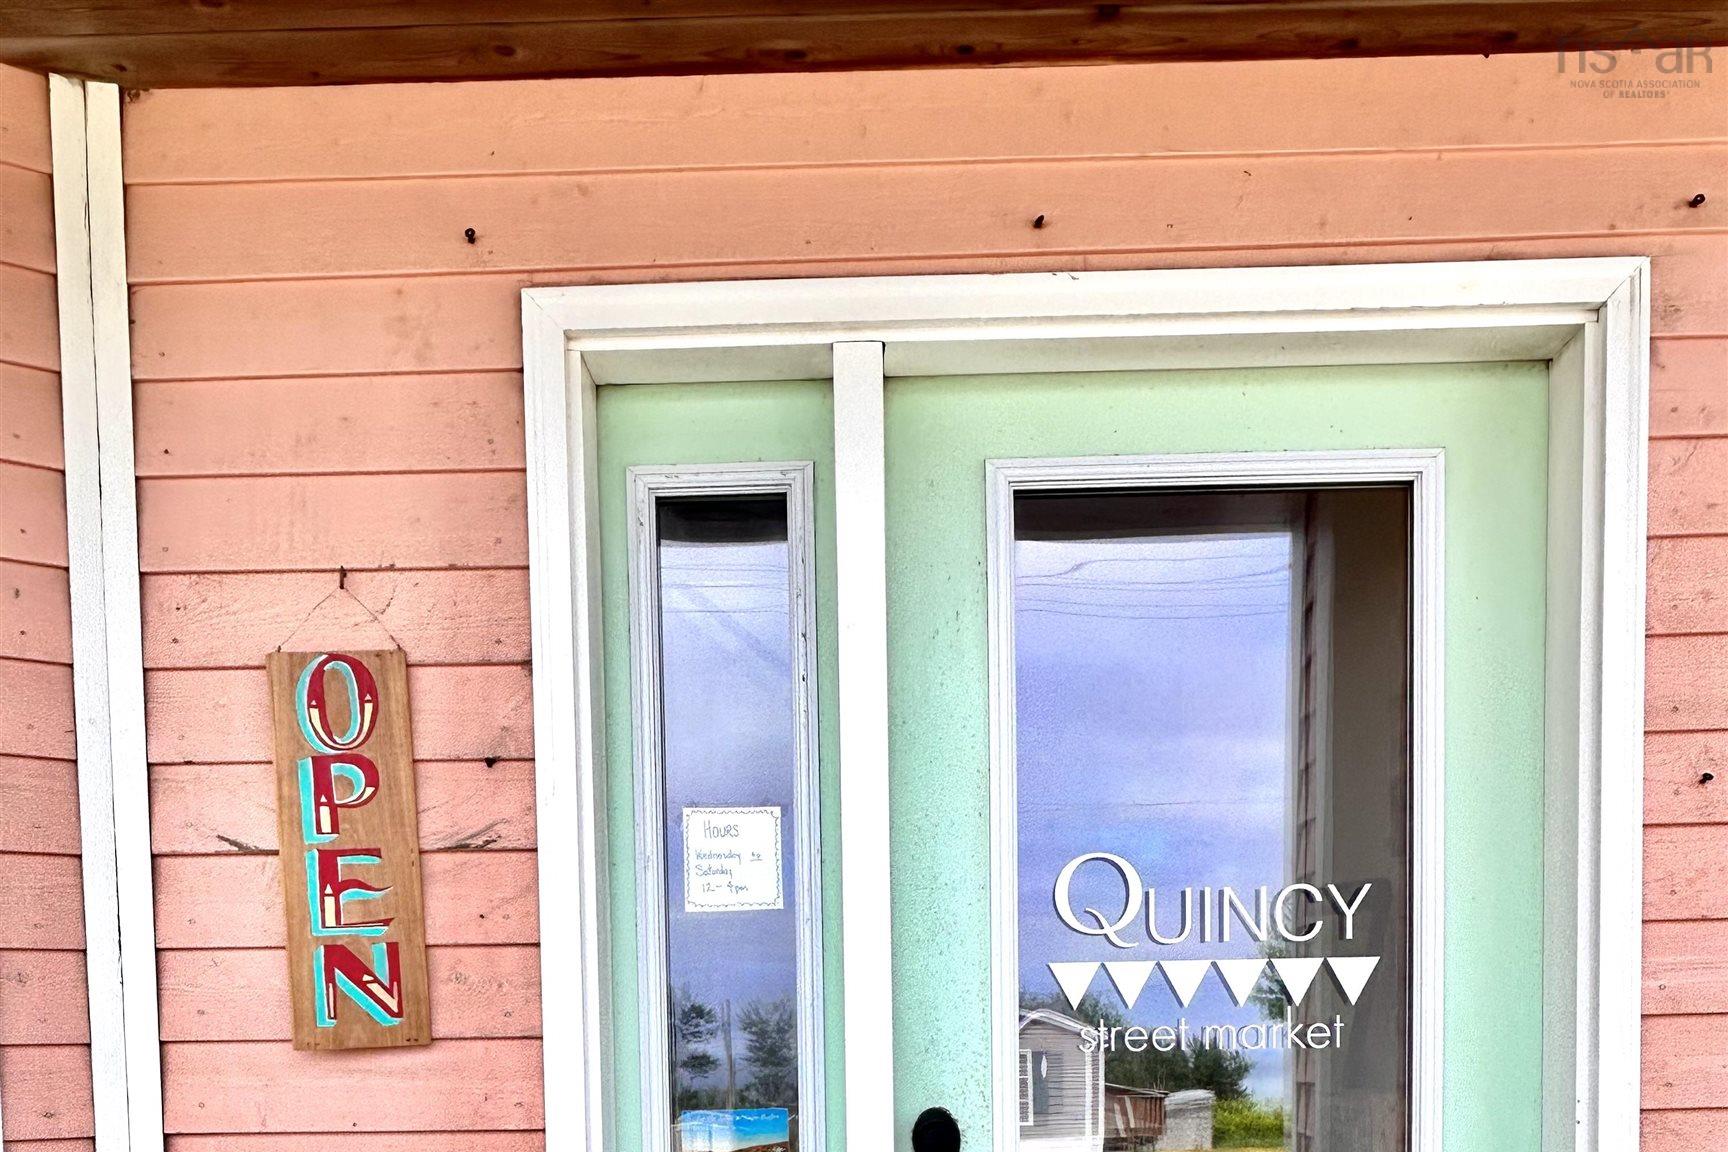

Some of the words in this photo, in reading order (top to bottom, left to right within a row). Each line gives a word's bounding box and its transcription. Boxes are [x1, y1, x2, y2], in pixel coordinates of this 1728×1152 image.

[296, 653, 404, 1028] OPEN
[695, 864, 733, 879] Saturday
[1078, 1017, 1189, 1052] street
[1205, 1005, 1345, 1050] market
